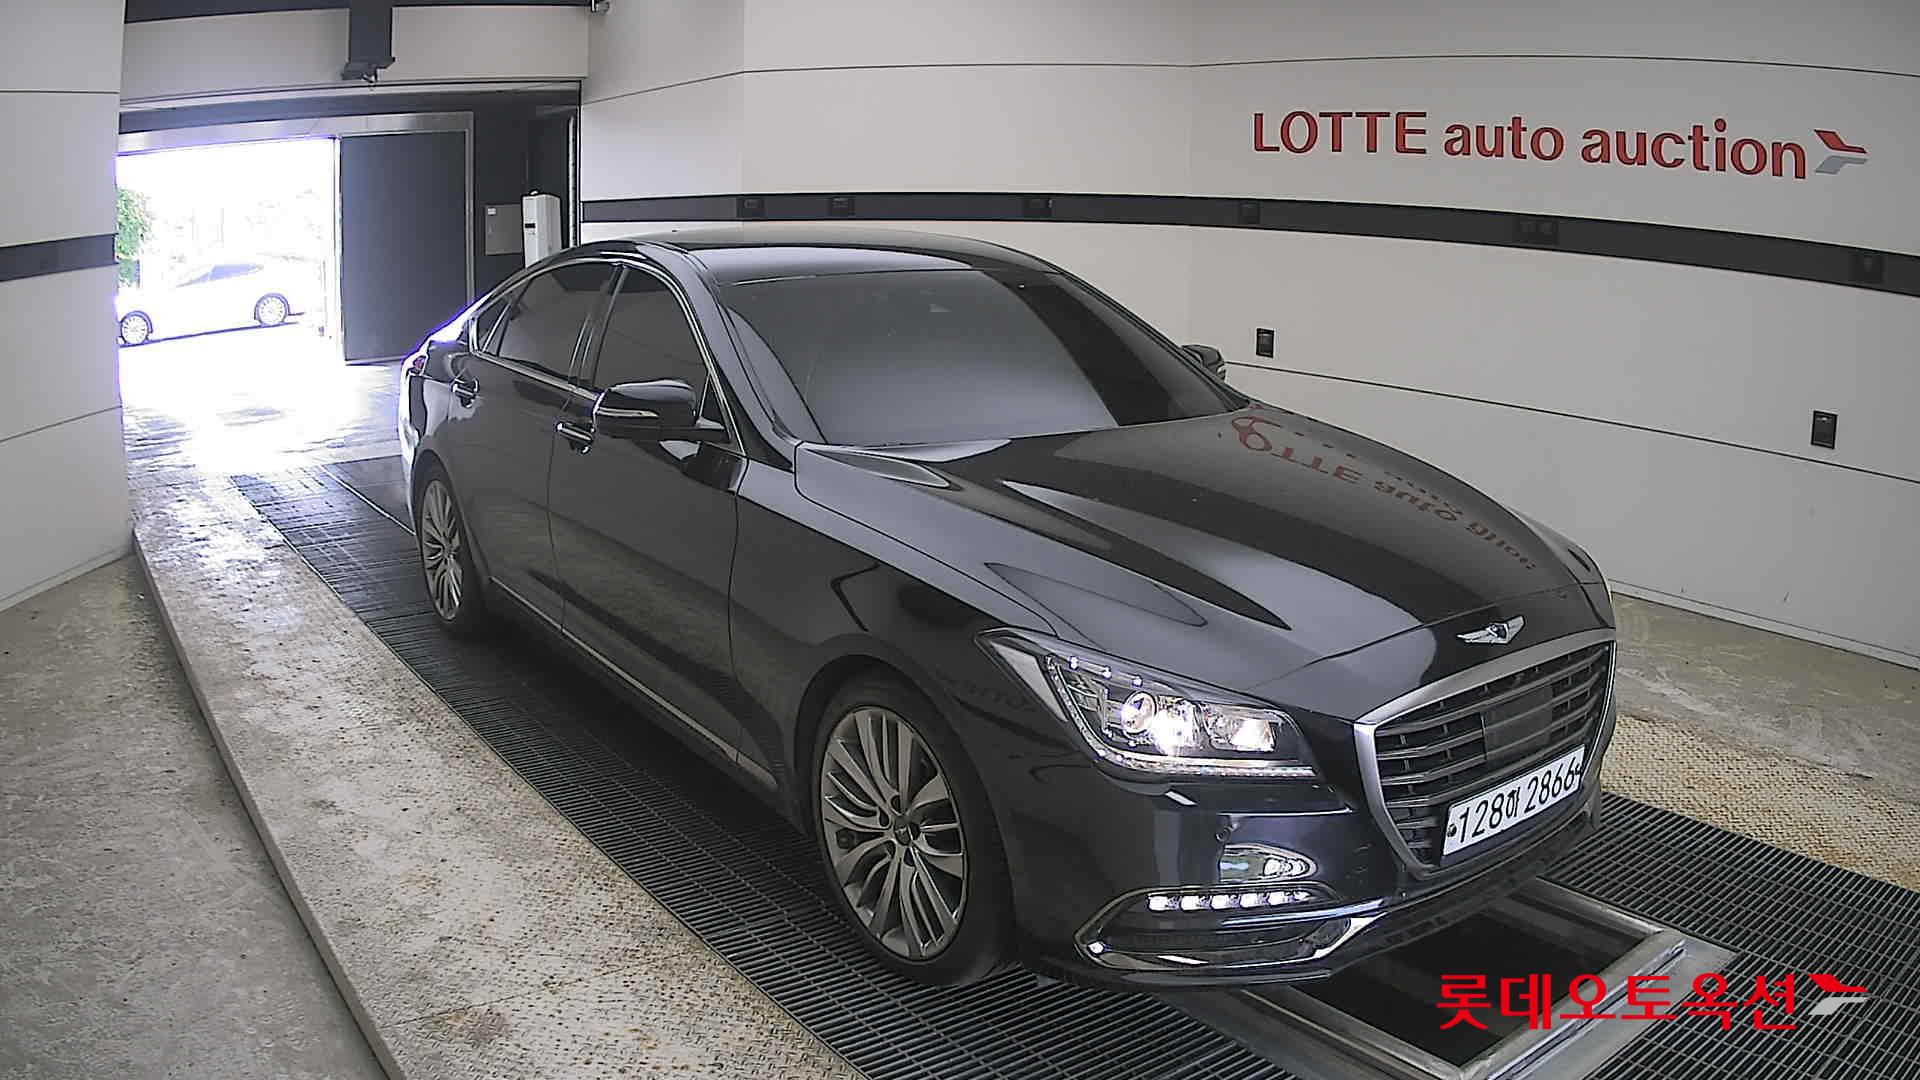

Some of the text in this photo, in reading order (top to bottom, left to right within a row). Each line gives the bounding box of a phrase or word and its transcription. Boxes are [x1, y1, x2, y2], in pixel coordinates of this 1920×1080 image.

[1253, 111, 1807, 180] LOTTE auto auction
[1524, 756, 1577, 814] 2866
